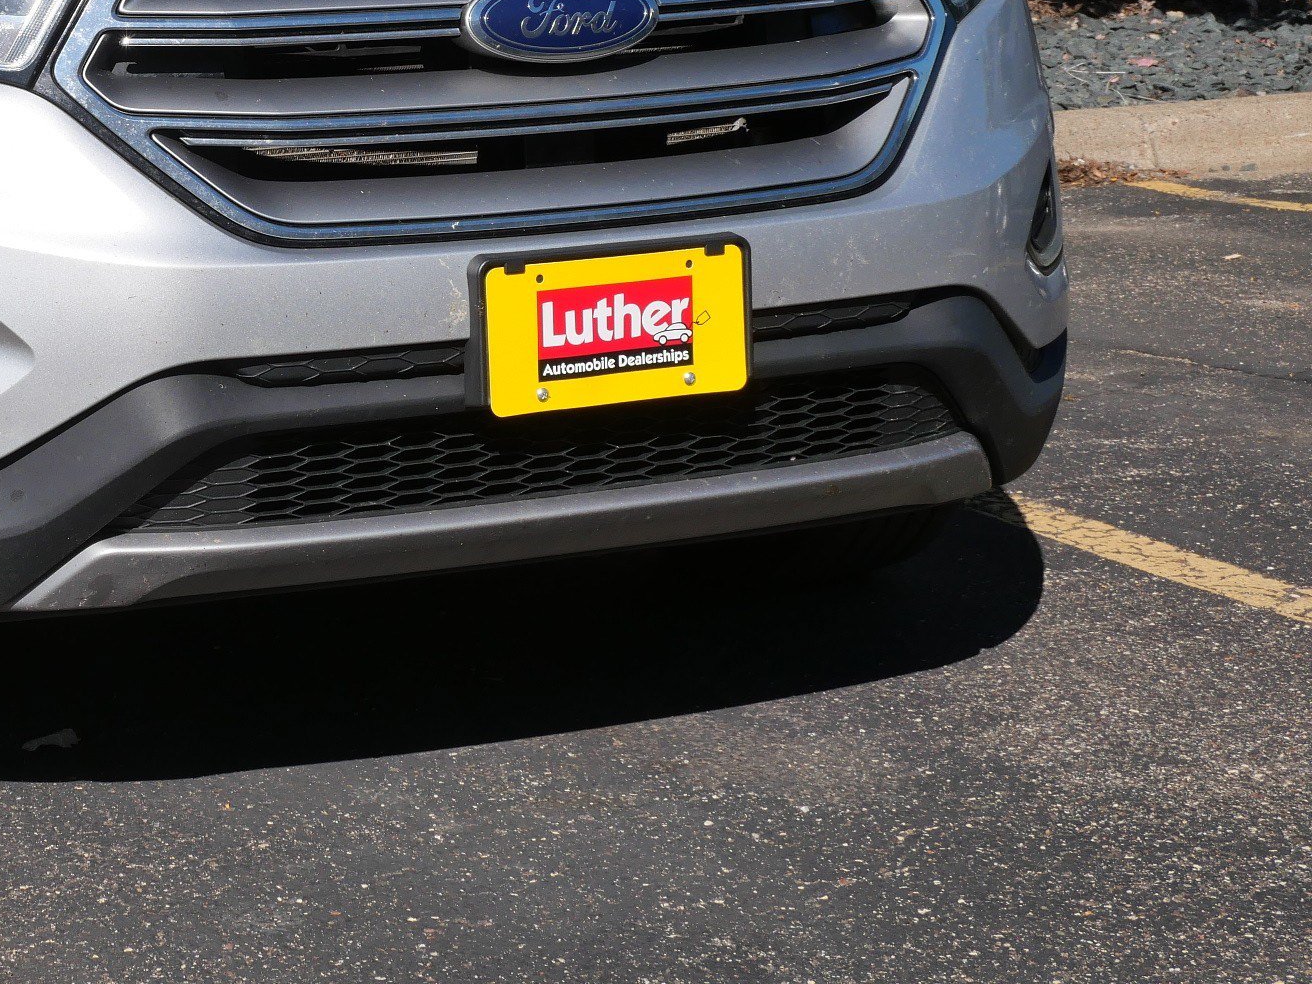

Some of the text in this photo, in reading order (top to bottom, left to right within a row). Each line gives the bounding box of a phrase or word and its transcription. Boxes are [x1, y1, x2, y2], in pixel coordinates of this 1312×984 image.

[542, 293, 690, 348] Luther
[542, 349, 690, 376] Automobile Dealerships
